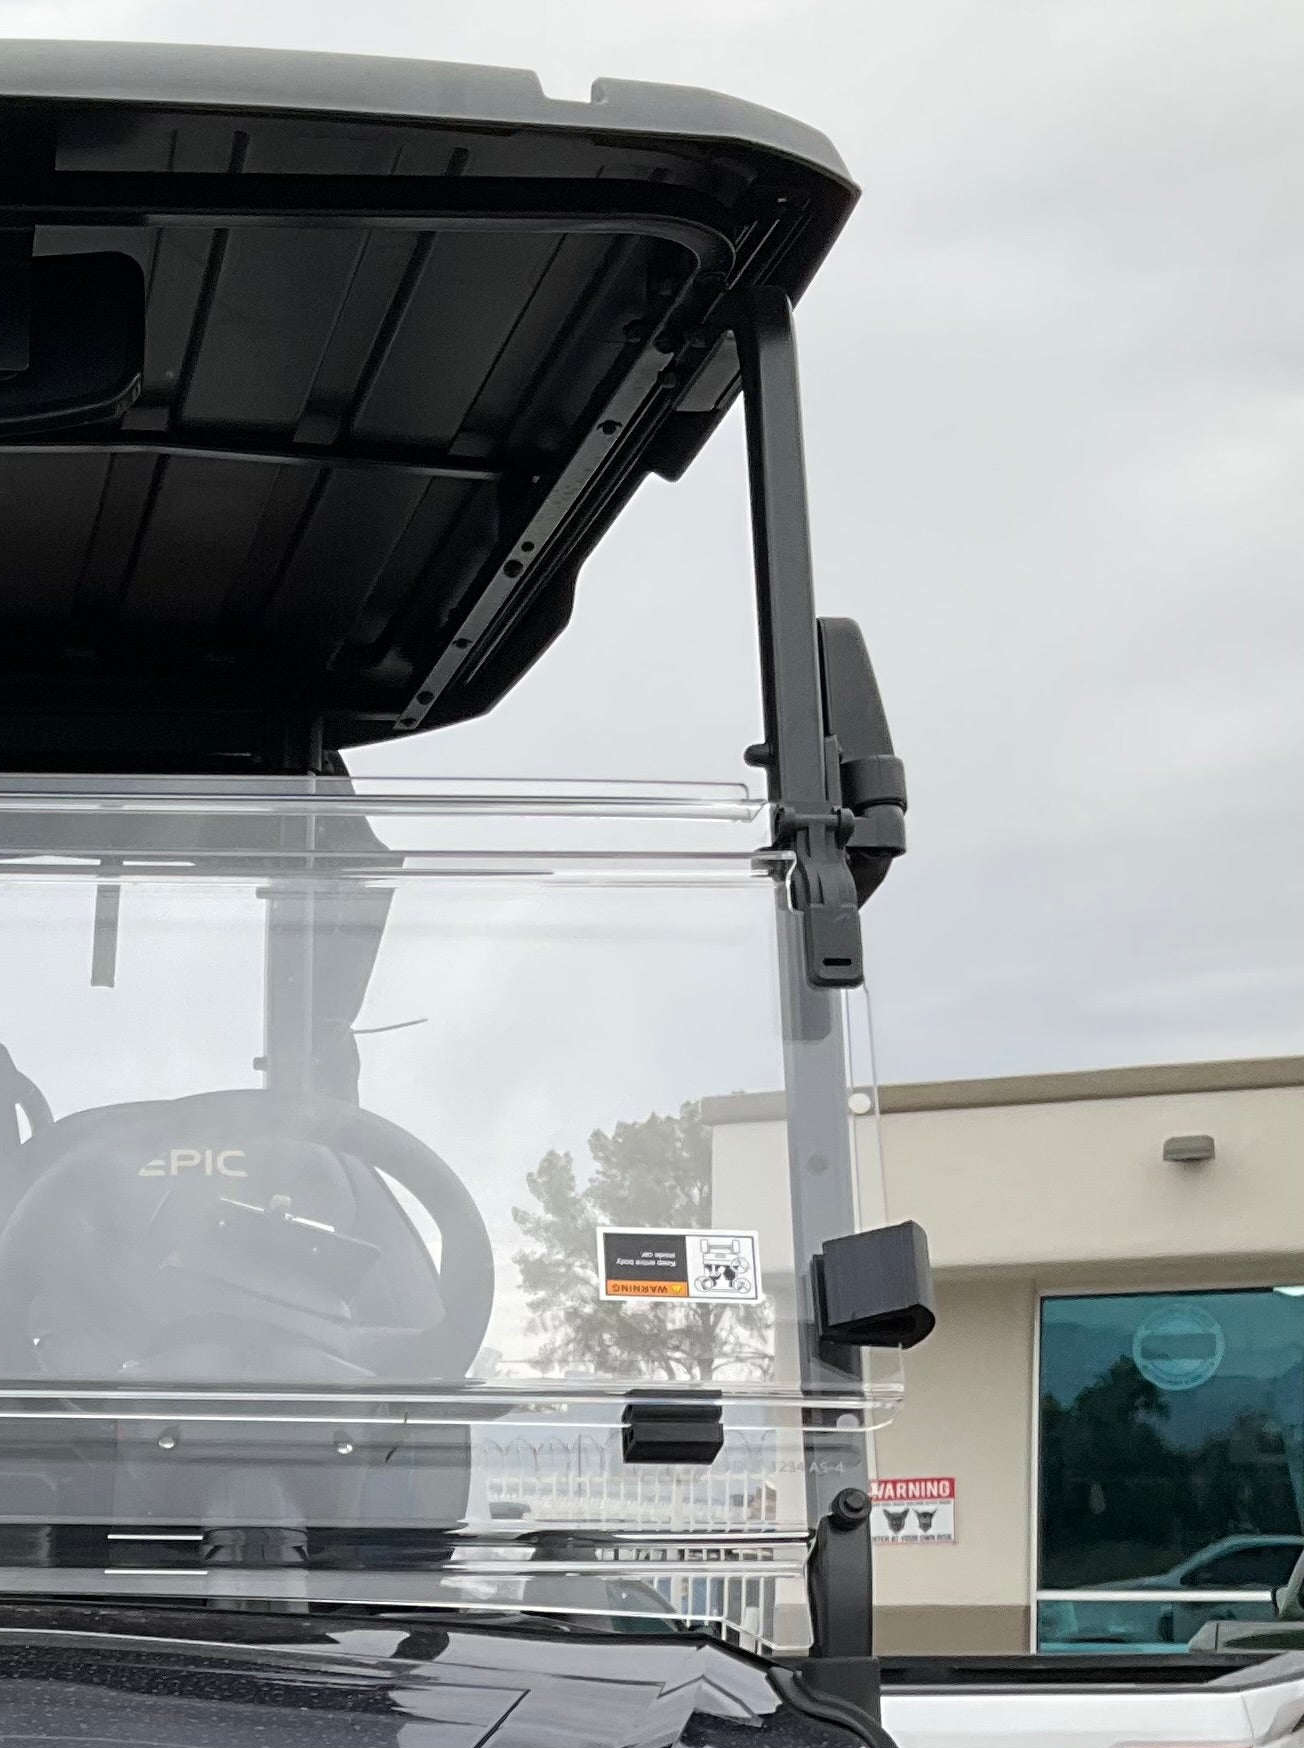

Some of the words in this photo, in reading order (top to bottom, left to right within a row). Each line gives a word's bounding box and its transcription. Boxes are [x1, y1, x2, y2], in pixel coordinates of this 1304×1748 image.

[616, 1257, 634, 1265] body
[612, 1284, 668, 1293] WARNING
[870, 1480, 950, 1499] WARNING
